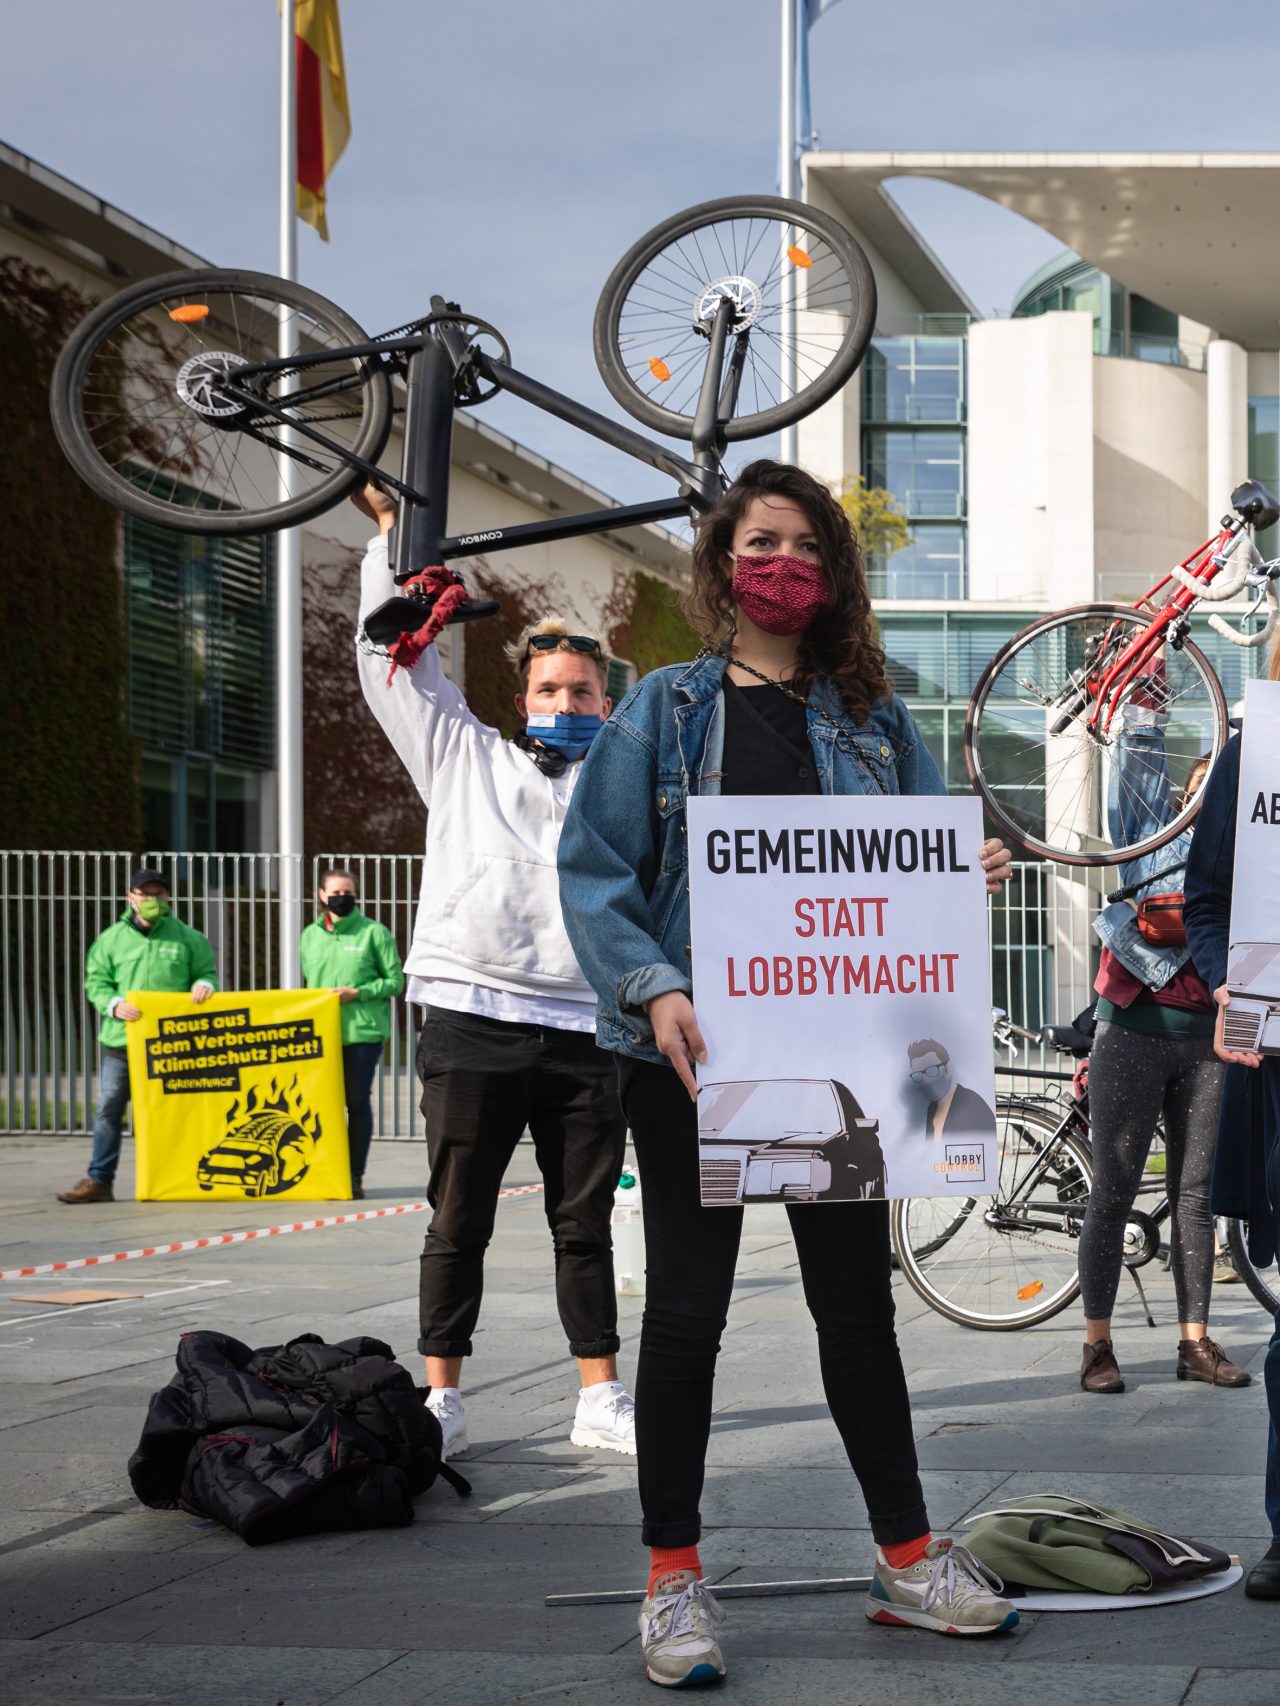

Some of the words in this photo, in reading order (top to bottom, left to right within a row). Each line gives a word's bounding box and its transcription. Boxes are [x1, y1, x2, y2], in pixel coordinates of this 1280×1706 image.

[706, 828, 970, 874] GEMEINWOHL
[794, 897, 889, 937] STATT
[726, 953, 959, 997] LOBBYMACHT
[149, 1039, 191, 1056] dem
[193, 1025, 297, 1050] Verbrenner
[162, 1016, 210, 1035] Raus
[212, 1013, 246, 1029] aus
[152, 1047, 268, 1075] Klimaschutz
[270, 1039, 320, 1063] jetzt!
[165, 1077, 236, 1091] GREENPEACE
[949, 1154, 982, 1166] LOBBY
